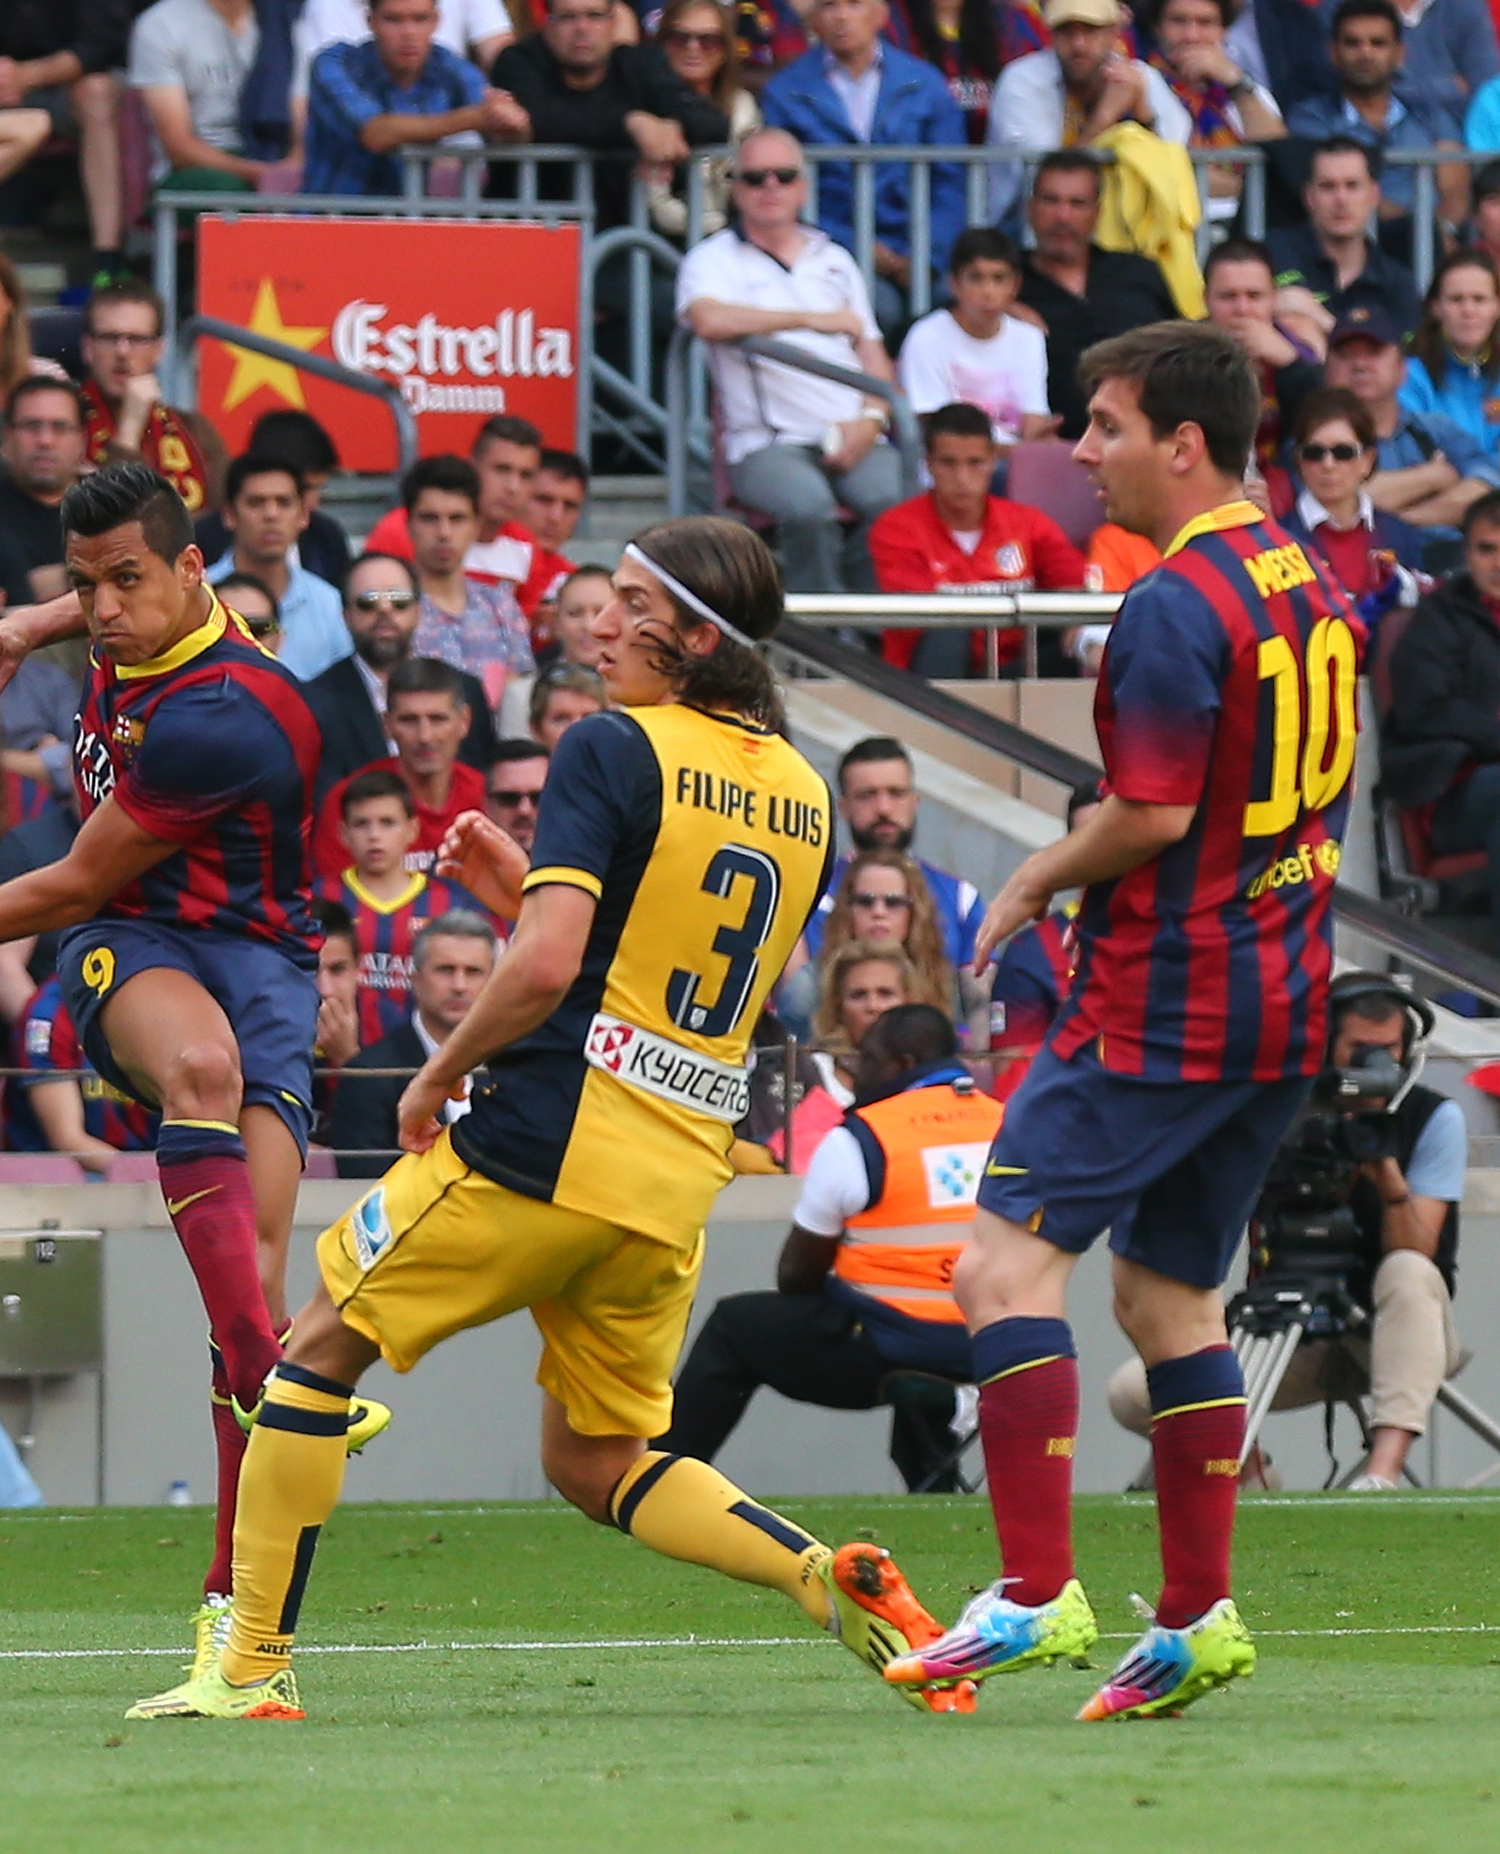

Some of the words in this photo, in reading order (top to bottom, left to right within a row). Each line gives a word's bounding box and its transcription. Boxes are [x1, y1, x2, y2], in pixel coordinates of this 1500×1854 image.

[330, 298, 574, 379] Estrella
[401, 374, 506, 416] Damm
[1242, 541, 1318, 599] MESSI
[1243, 616, 1357, 836] 10
[676, 766, 757, 828] FILIPE
[768, 795, 823, 848] LUIS
[1246, 843, 1315, 900] unicef
[81, 946, 116, 1000] 9
[666, 842, 781, 1038] 3
